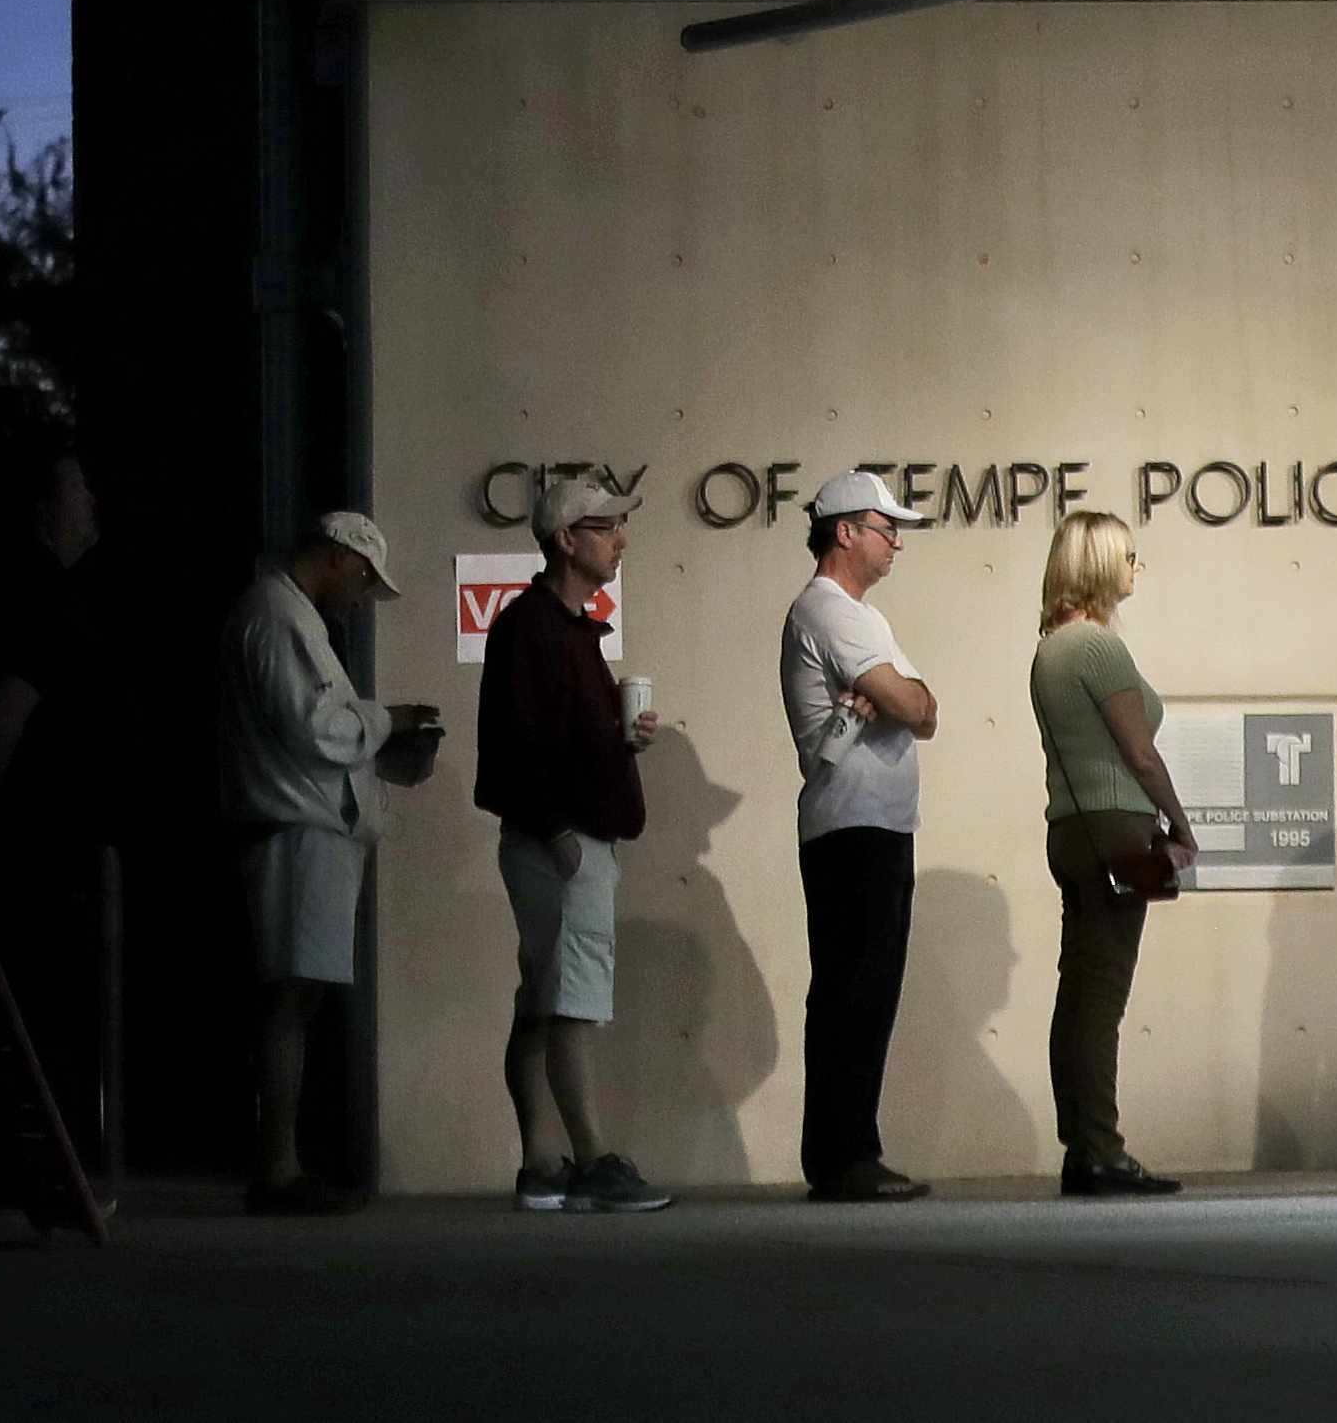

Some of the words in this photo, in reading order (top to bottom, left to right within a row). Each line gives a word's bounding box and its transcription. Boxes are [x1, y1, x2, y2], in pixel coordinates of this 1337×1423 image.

[694, 462, 801, 529] OF
[1206, 809, 1249, 823] POLICE
[1253, 807, 1329, 823] SUBSTATION
[1270, 829, 1311, 848] 1995
